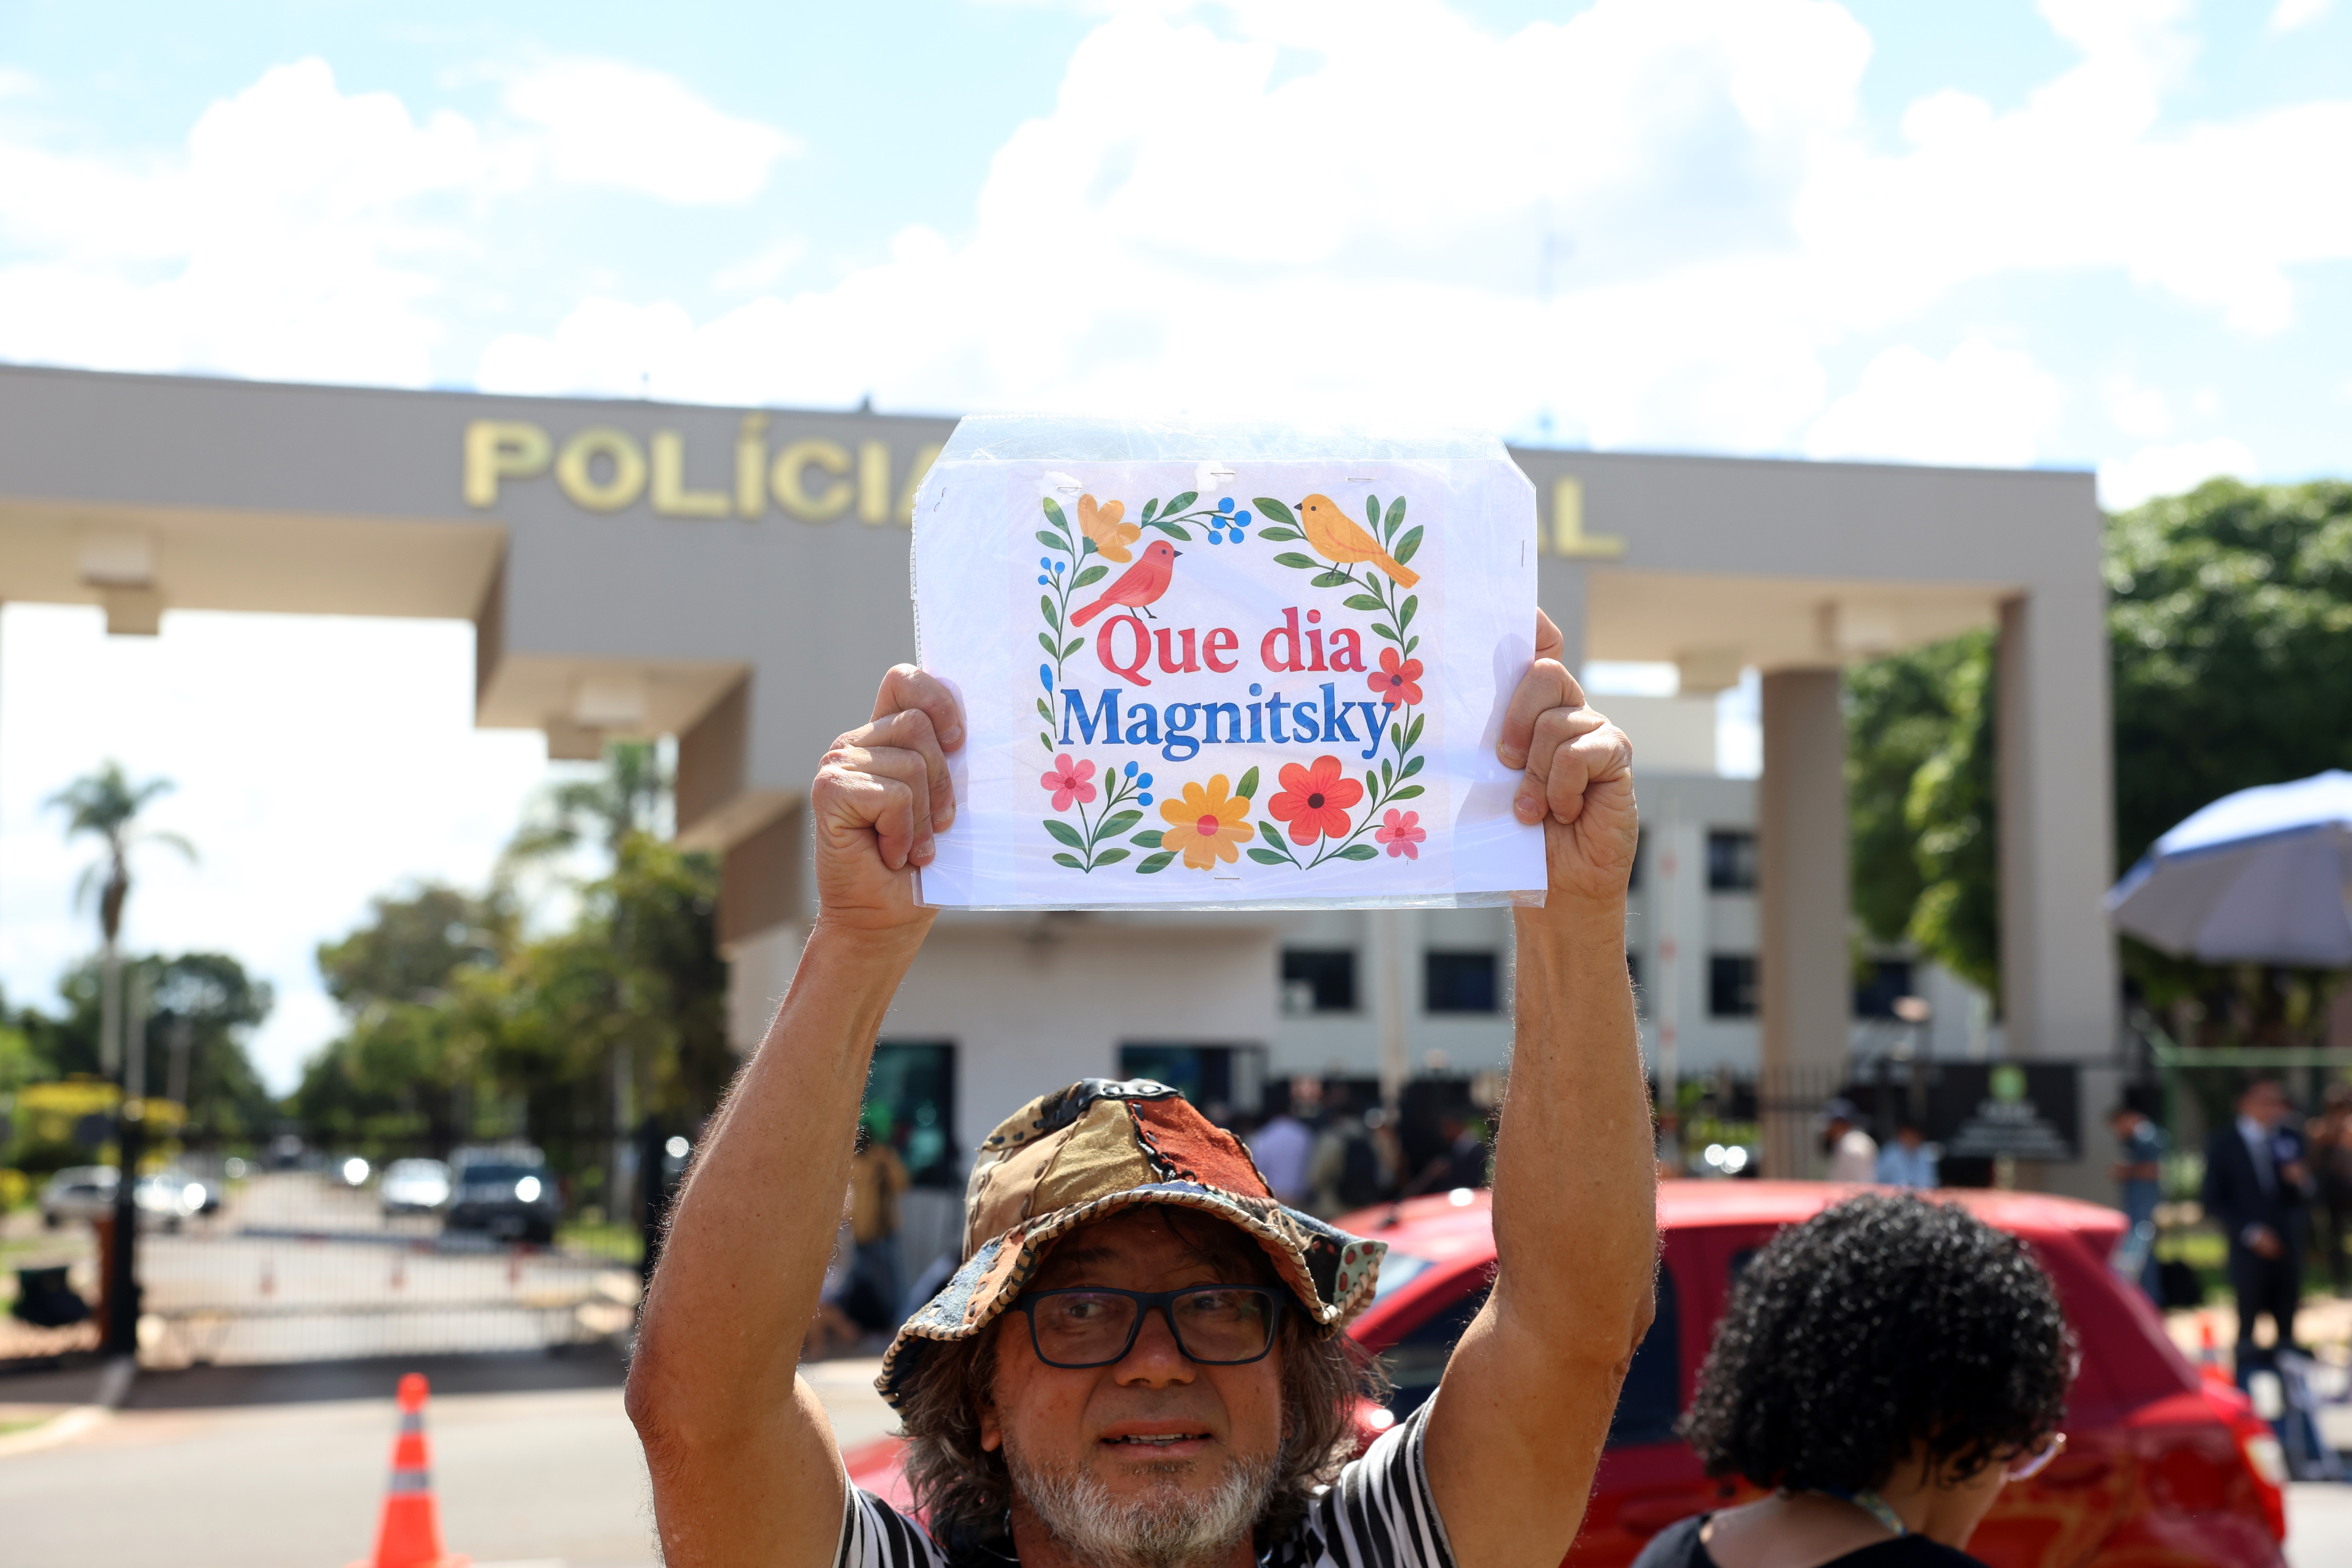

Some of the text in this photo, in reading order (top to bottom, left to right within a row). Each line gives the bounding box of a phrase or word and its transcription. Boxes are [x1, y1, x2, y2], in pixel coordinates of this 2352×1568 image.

[1096, 606, 1367, 687] Que dia
[1058, 682, 1396, 762] Magnitsky
